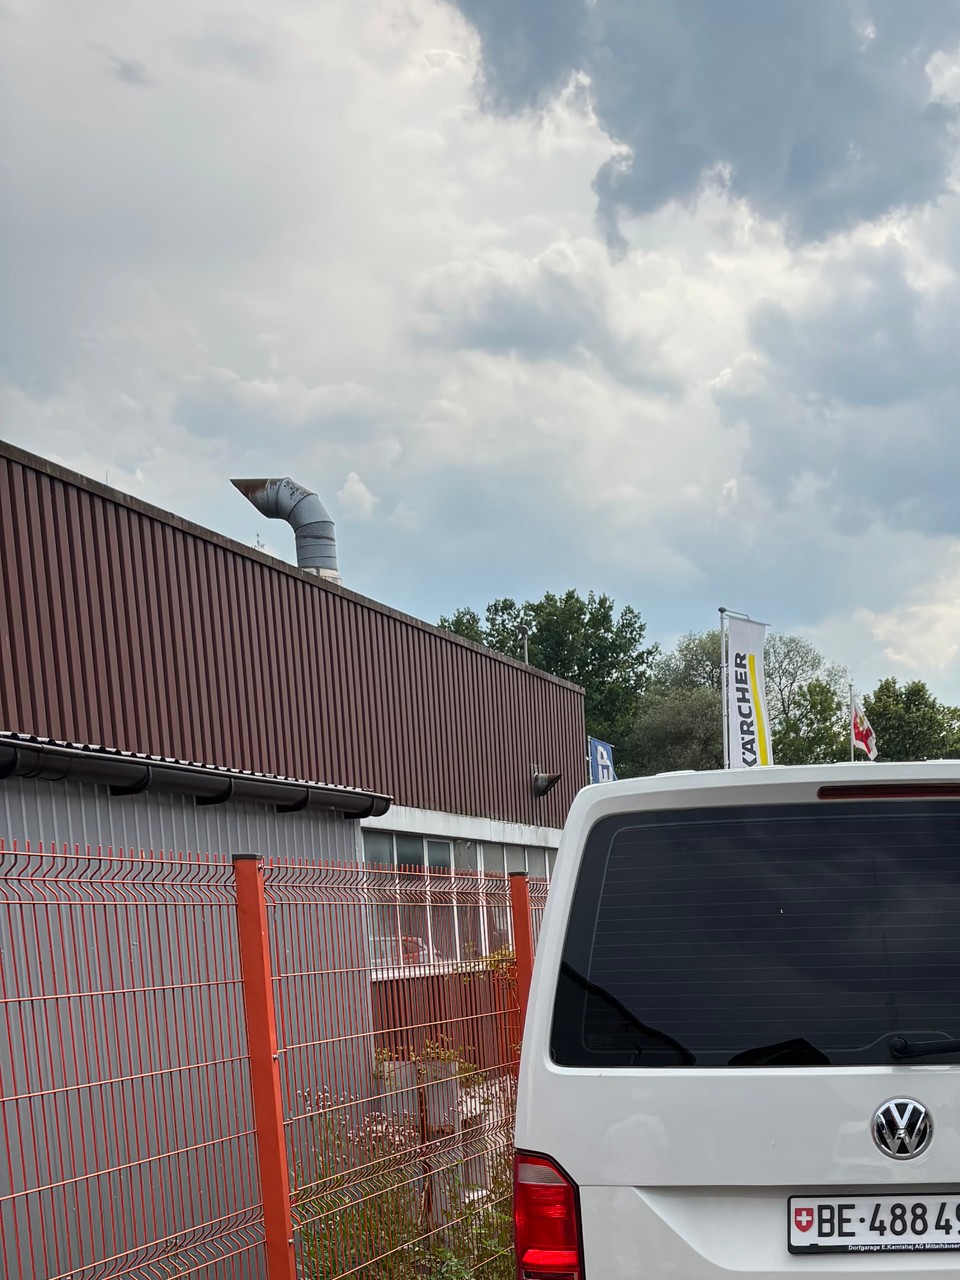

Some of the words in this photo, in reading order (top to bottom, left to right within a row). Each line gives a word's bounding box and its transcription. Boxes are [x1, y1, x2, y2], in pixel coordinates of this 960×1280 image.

[734, 652, 758, 767] KÄRCHER
[872, 1098, 933, 1160] VW
[848, 1244, 880, 1252] Dorfgarage
